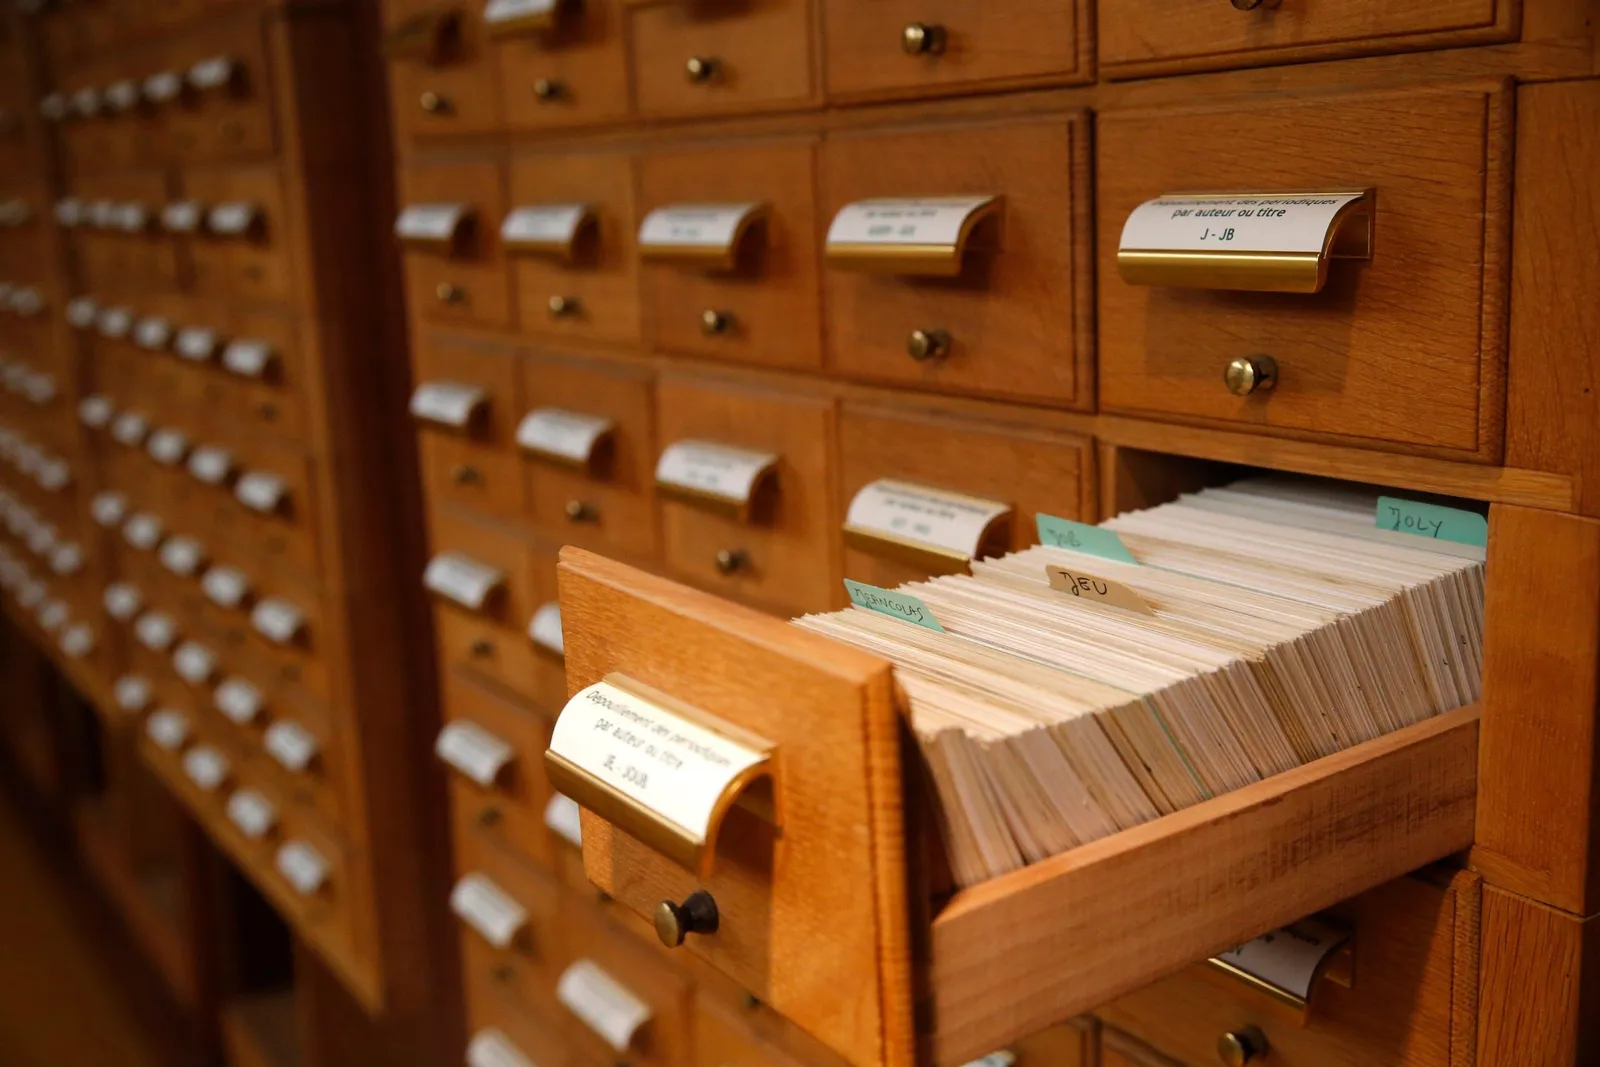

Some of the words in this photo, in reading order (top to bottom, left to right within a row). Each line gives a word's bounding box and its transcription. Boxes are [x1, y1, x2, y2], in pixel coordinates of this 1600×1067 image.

[1171, 208, 1194, 219] par
[1195, 207, 1236, 217] auteur
[1238, 208, 1255, 217] ou
[1256, 207, 1287, 217] titre
[1200, 228, 1209, 241] J
[1219, 228, 1236, 241] JB
[1388, 506, 1444, 538] JOLY
[1058, 571, 1108, 597] JEU
[854, 587, 924, 622] JEANCOLAS
[592, 717, 614, 732] par
